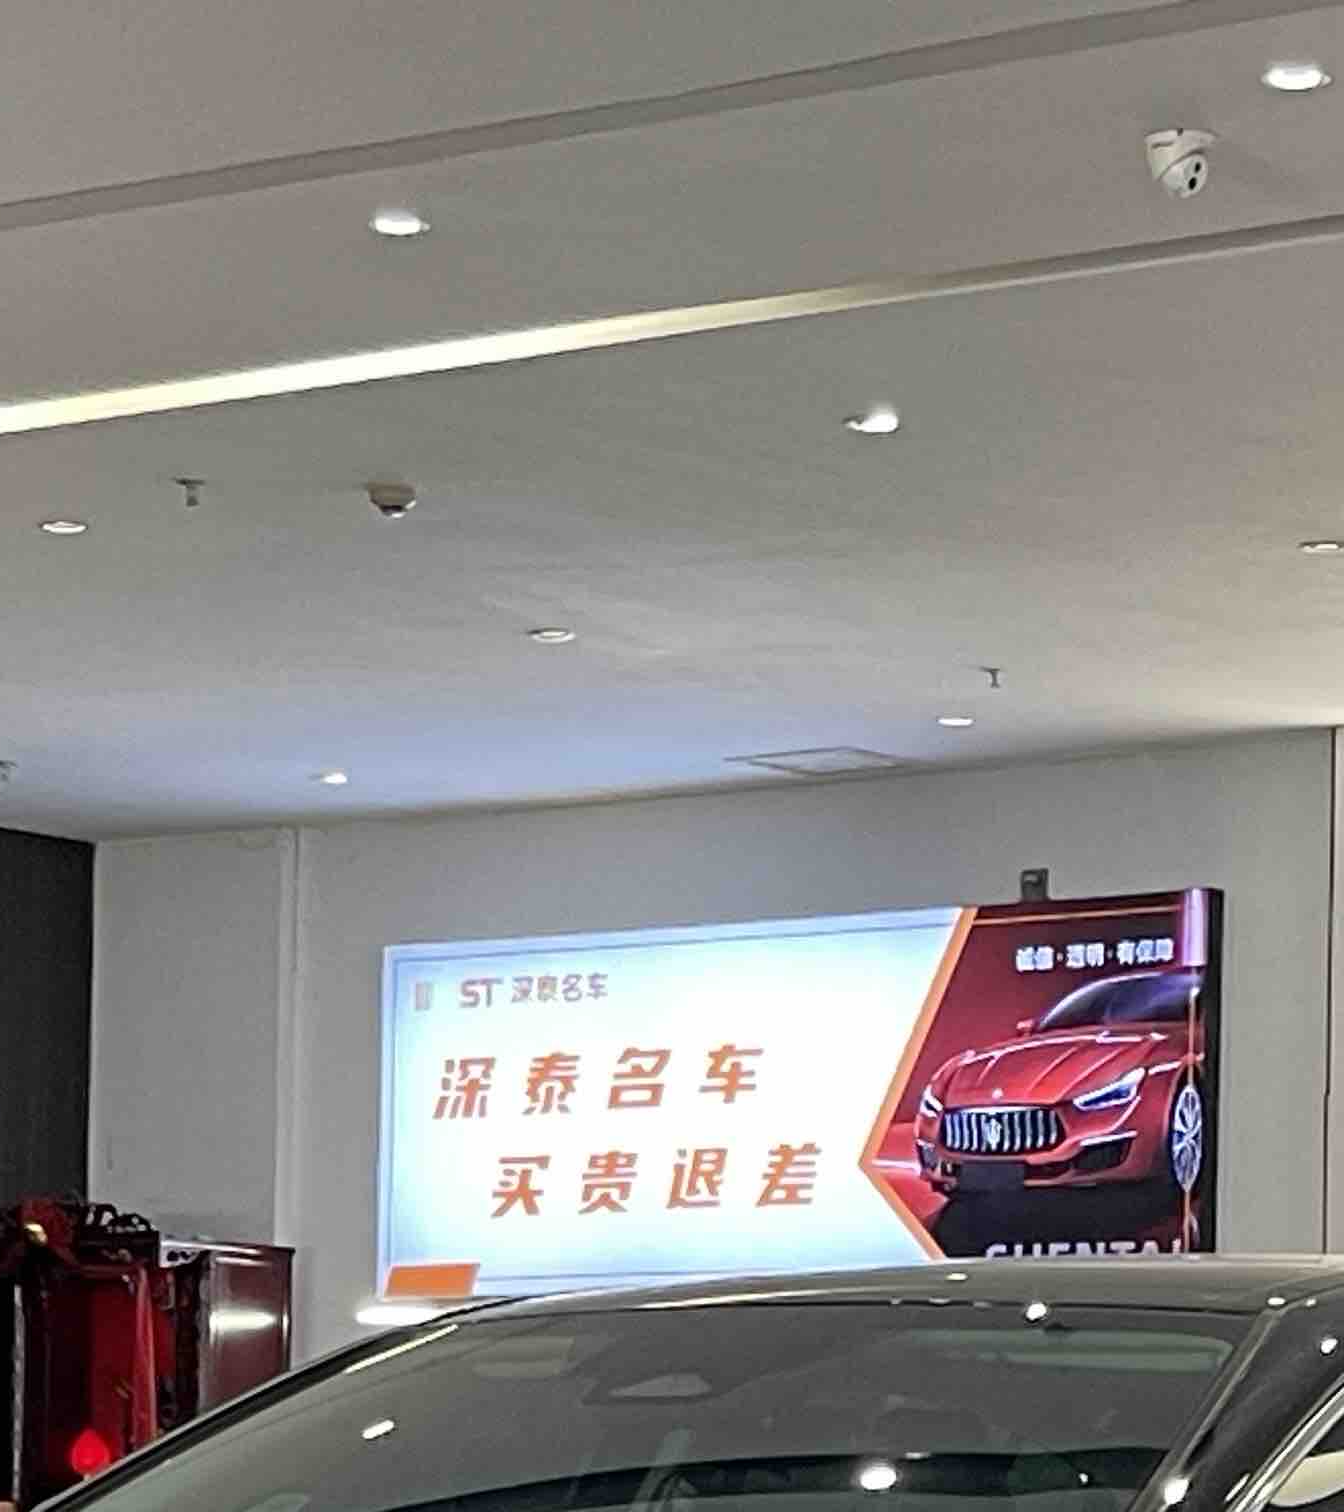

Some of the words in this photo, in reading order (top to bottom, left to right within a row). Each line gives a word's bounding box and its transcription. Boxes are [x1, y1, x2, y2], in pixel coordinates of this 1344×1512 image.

[432, 1044, 764, 1120] 深泰名车
[490, 1142, 823, 1219] 买贵退差
